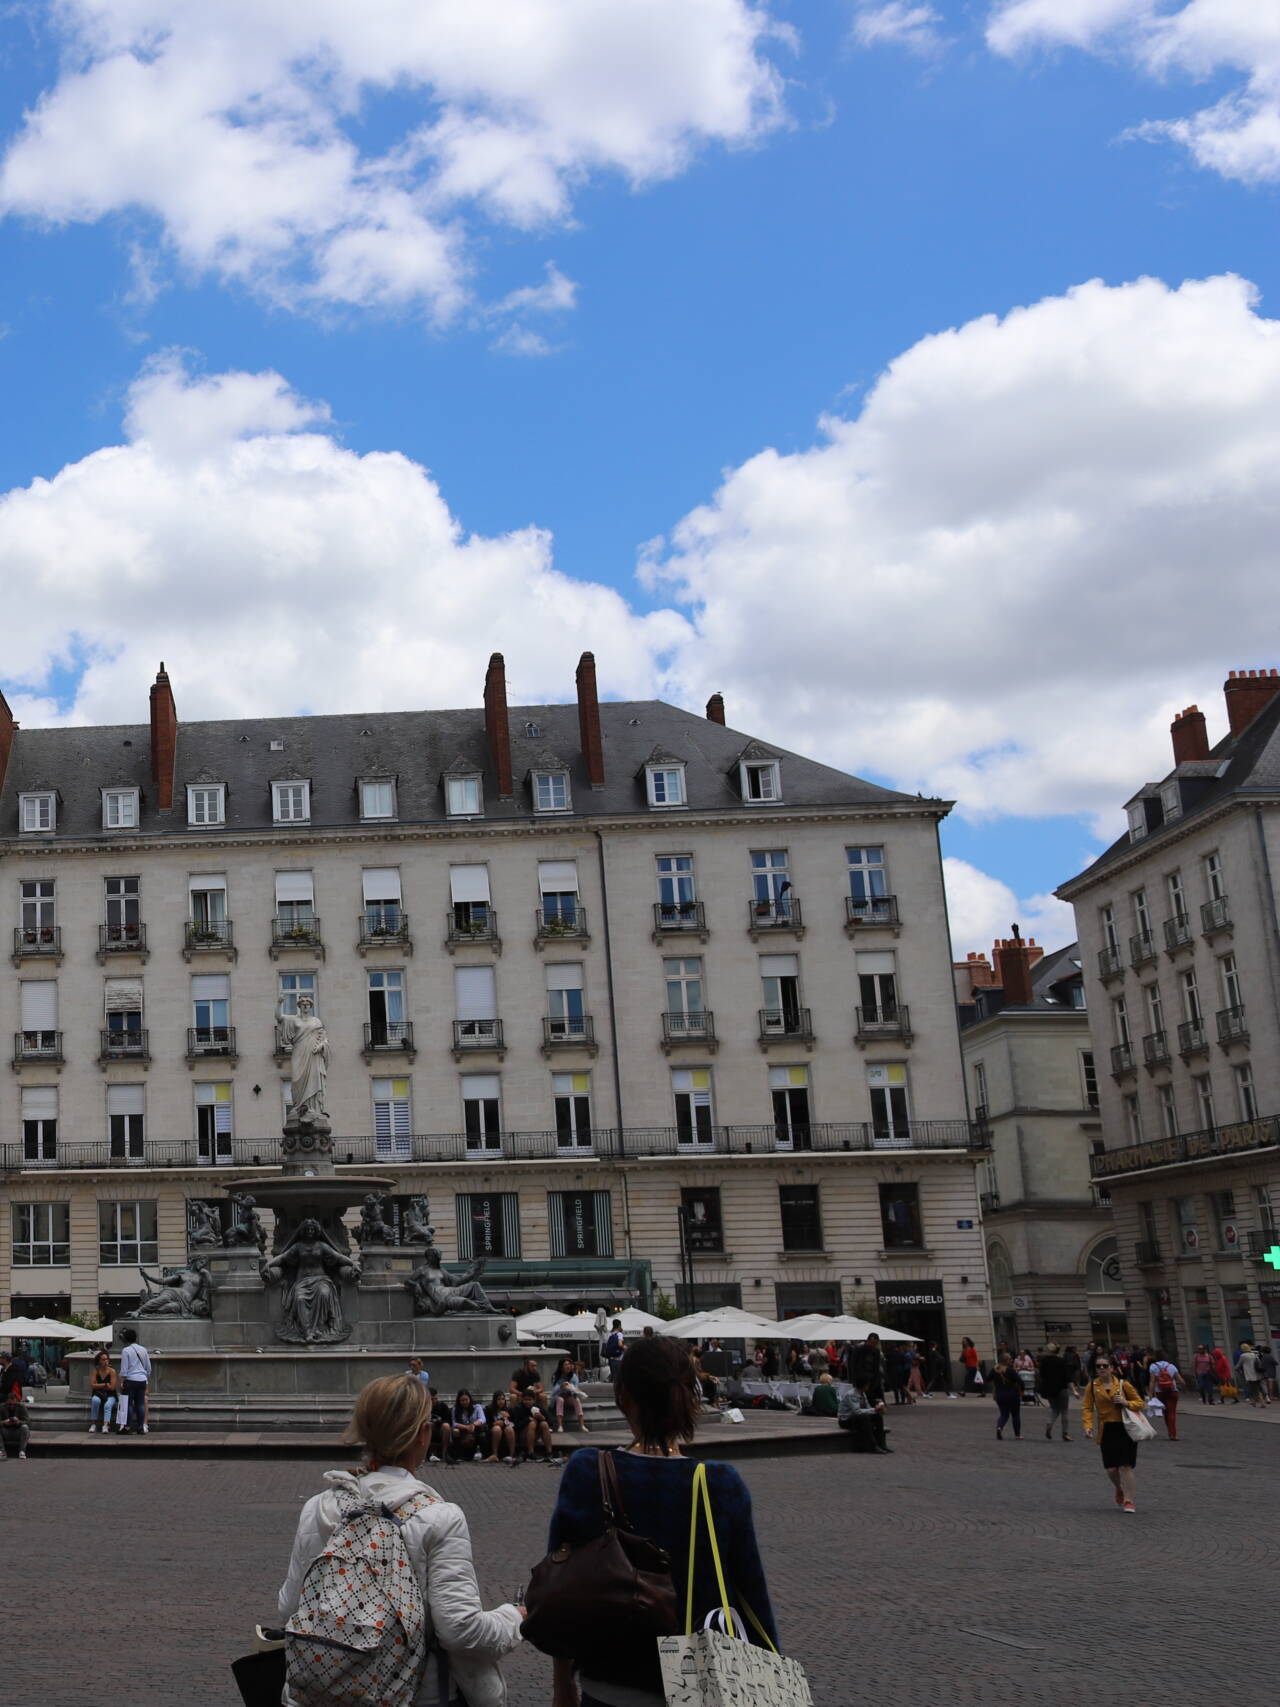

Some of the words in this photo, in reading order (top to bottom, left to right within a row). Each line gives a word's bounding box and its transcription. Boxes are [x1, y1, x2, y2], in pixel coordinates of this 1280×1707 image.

[1096, 1141, 1179, 1171] PHARMACIE
[1188, 1137, 1210, 1156] DE
[1221, 1122, 1273, 1151] PARIS
[483, 1200, 493, 1250] SPRINGFIELD
[575, 1199, 585, 1248] SPRINGFIELD
[878, 1295, 943, 1305] SPRINGFIELD
